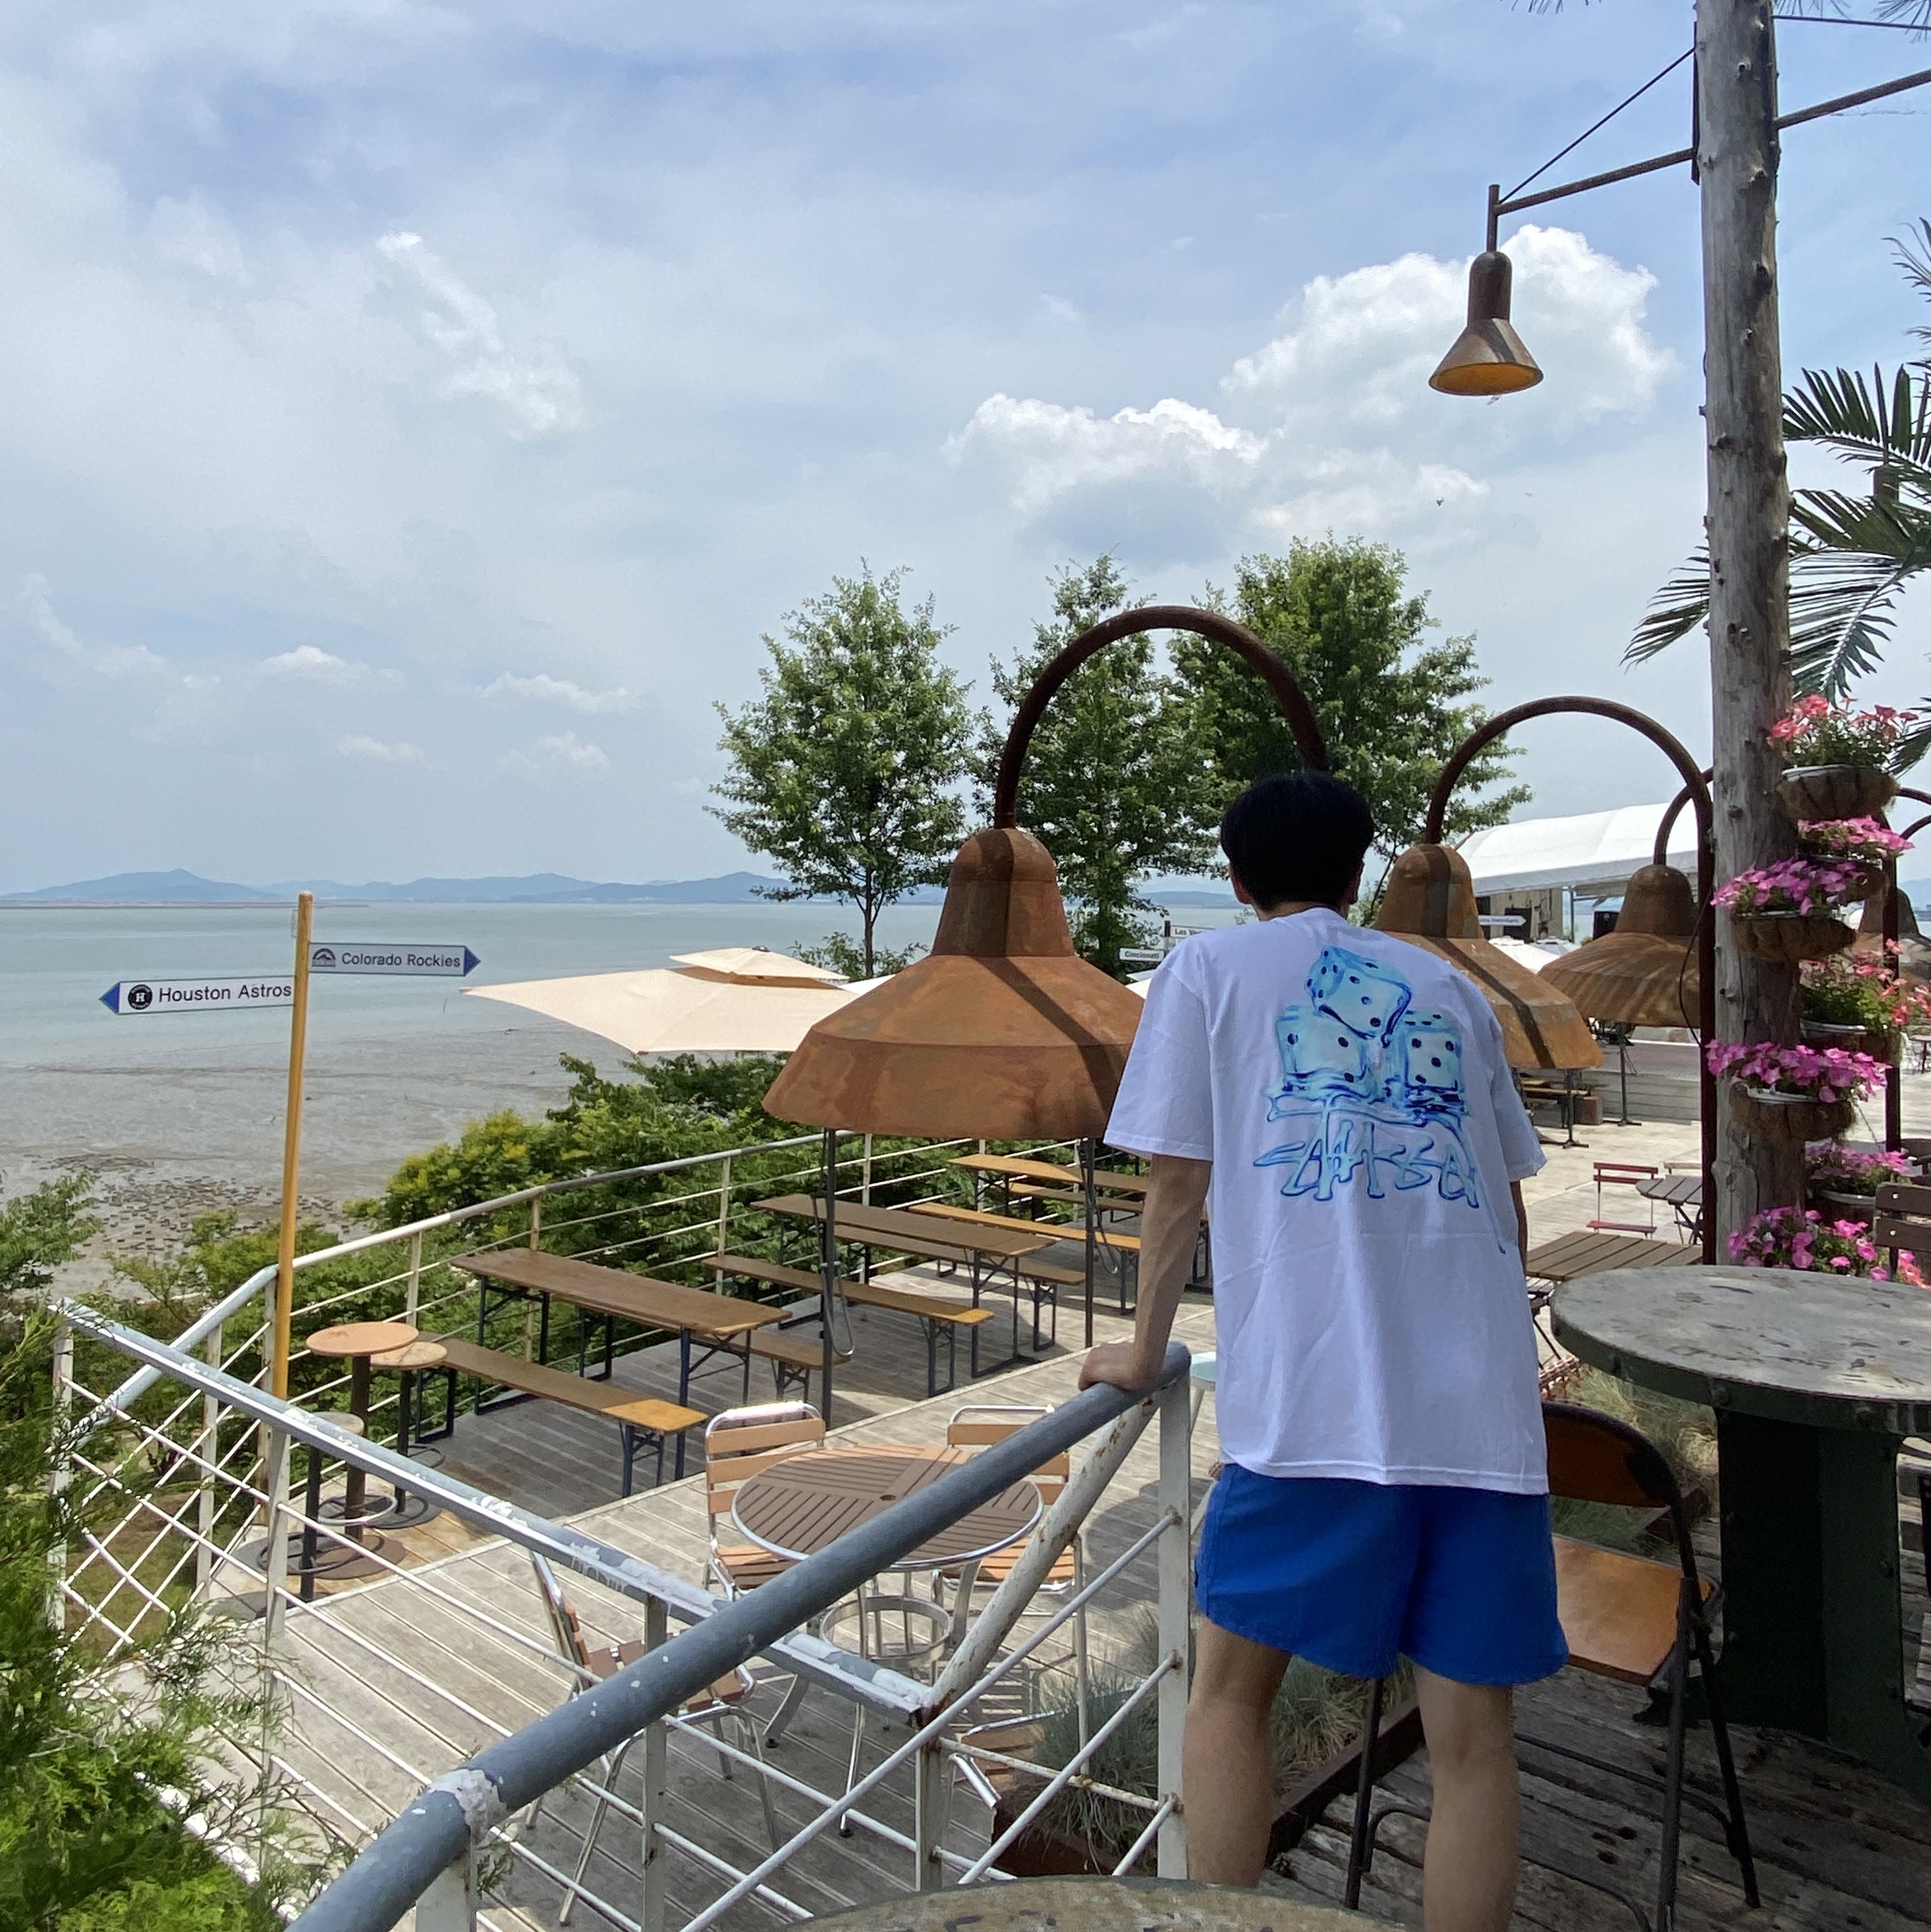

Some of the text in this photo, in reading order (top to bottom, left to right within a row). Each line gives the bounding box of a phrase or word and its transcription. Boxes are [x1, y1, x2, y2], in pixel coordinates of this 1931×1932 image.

[341, 952, 402, 966] Colorado
[407, 954, 461, 968] Rockies
[159, 985, 231, 1003] Houston
[237, 984, 292, 1000] Astros
